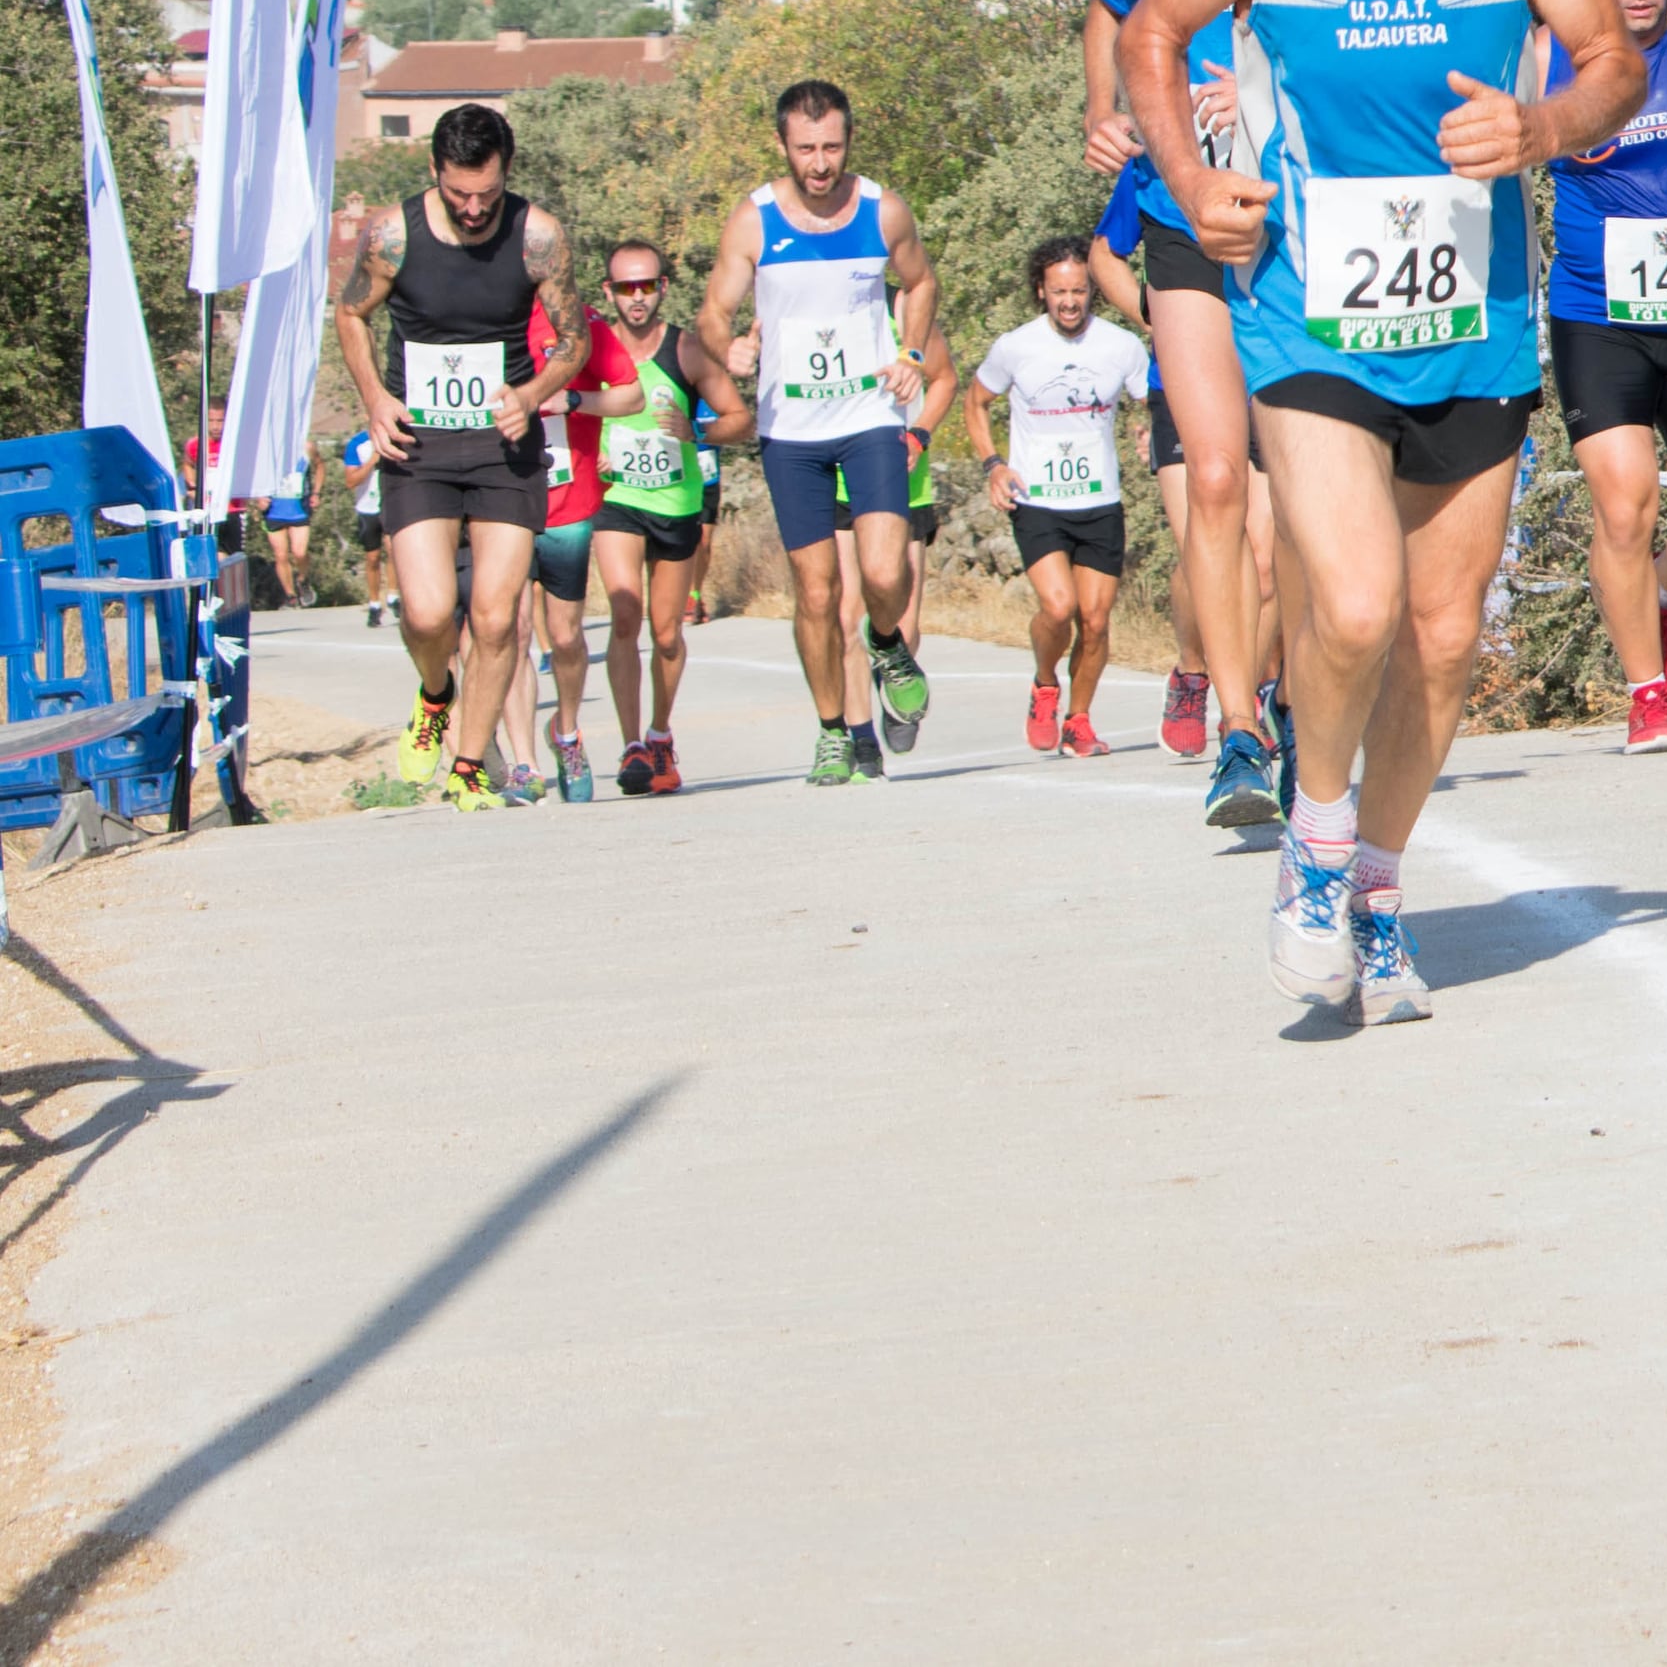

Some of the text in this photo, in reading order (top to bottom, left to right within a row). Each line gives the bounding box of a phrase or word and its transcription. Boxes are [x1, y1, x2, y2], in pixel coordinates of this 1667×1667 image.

[1619, 132, 1655, 147] JULIO
[1342, 244, 1457, 309] 248
[1340, 310, 1454, 334] DIPUTACIÓN DE
[1341, 323, 1454, 350] TOLEDO
[808, 348, 847, 381] 91
[426, 376, 485, 408] 100
[424, 416, 487, 426] TOLEDO
[622, 450, 670, 474] 286
[1043, 456, 1090, 483] 106
